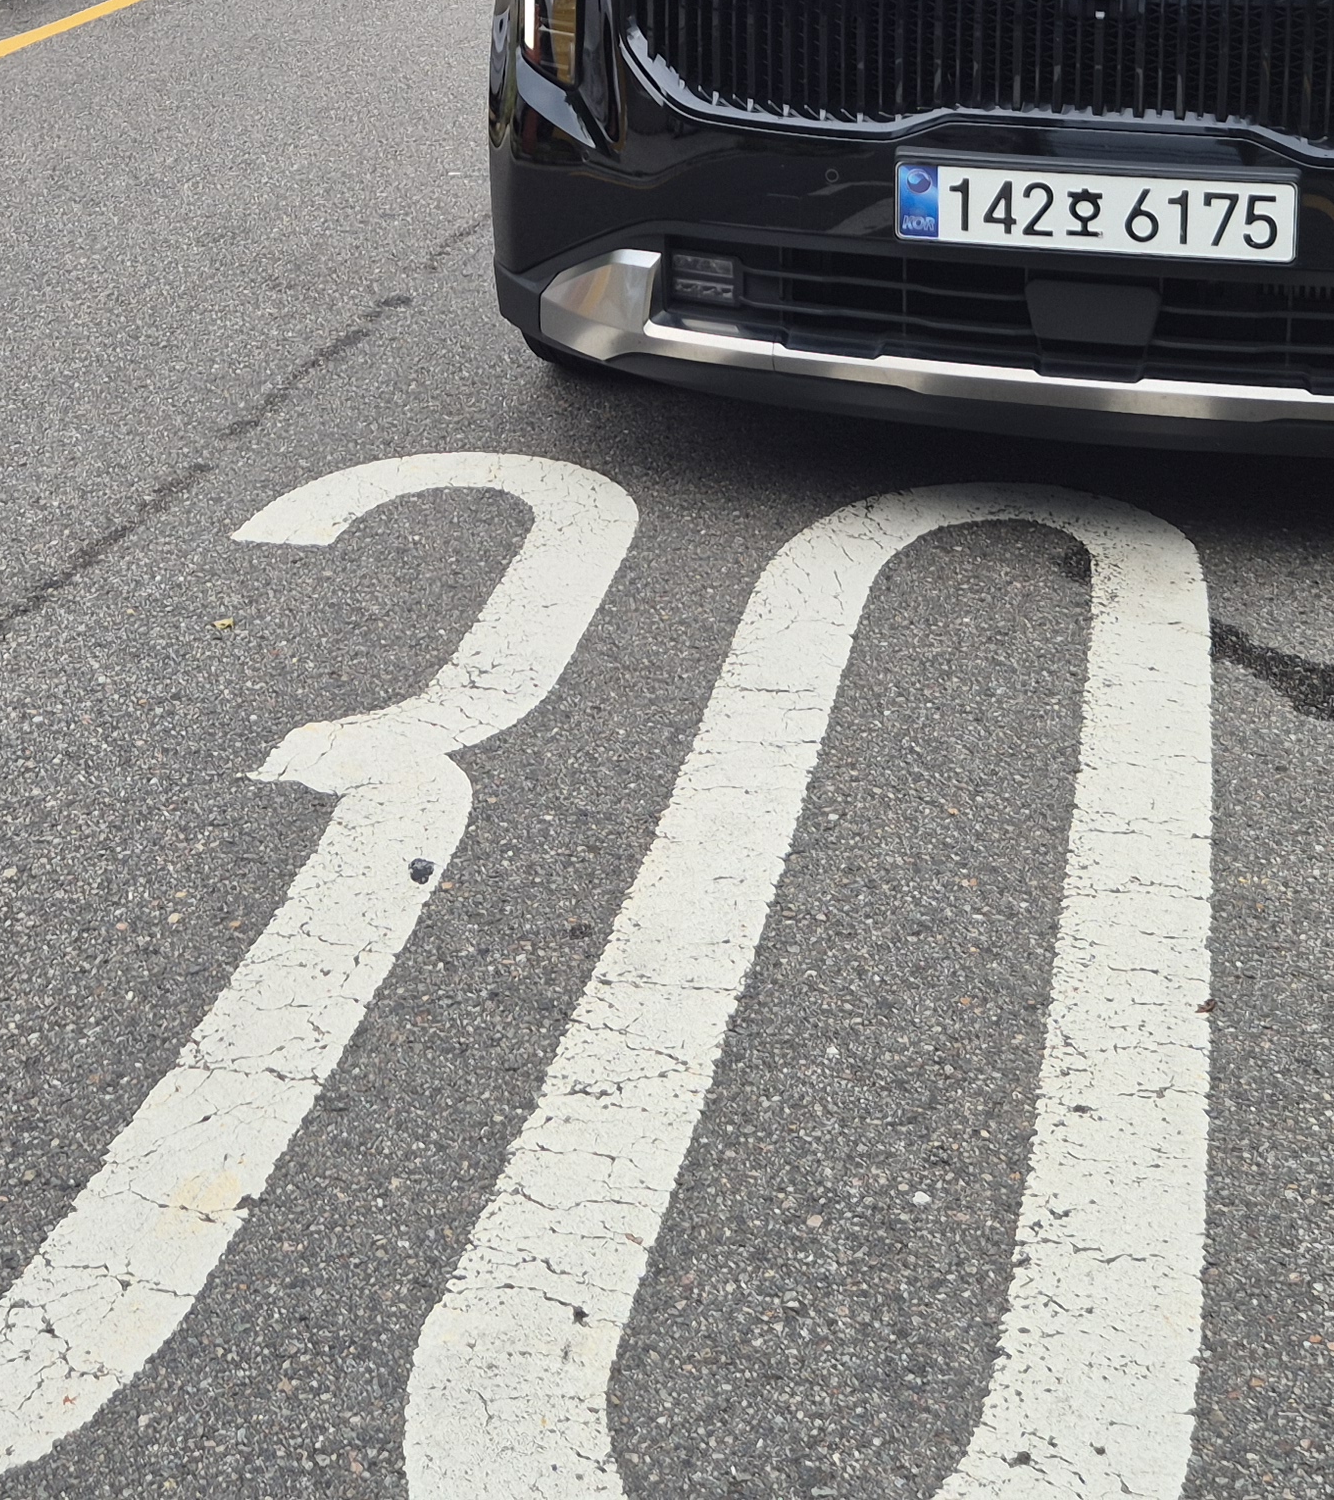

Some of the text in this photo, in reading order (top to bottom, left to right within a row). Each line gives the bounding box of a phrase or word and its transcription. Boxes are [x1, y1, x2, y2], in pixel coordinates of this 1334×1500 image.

[901, 214, 936, 231] KOR
[948, 177, 1279, 250] 142호 6175
